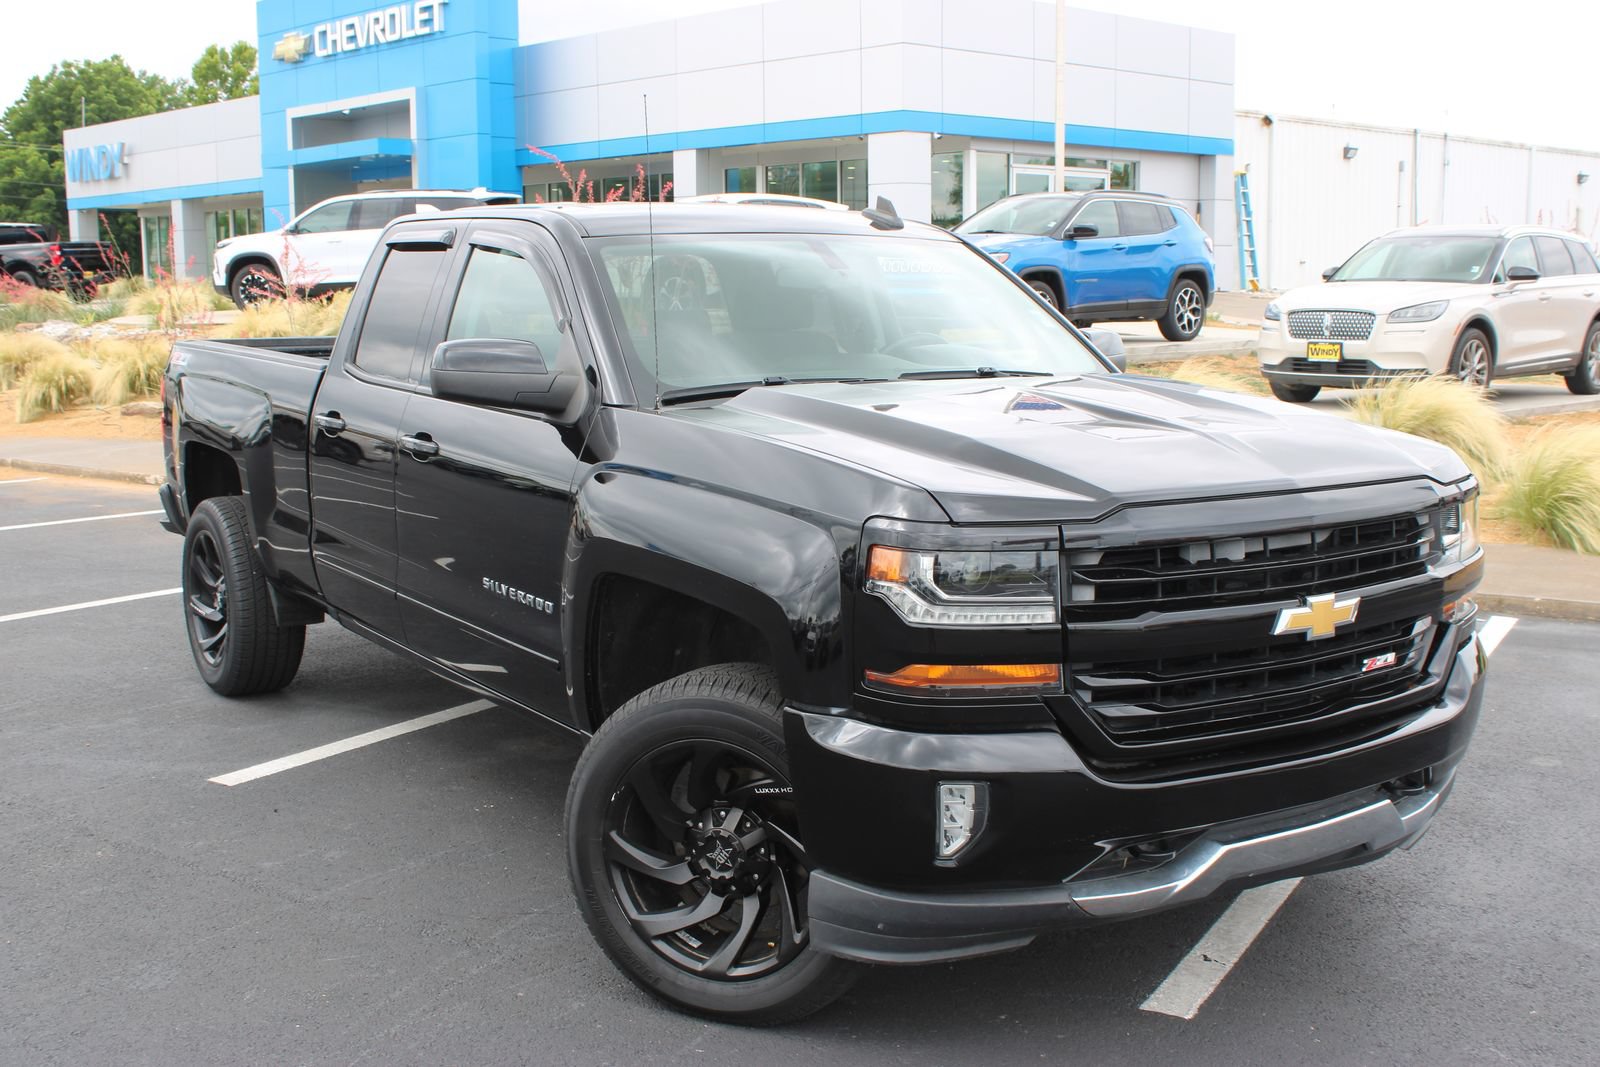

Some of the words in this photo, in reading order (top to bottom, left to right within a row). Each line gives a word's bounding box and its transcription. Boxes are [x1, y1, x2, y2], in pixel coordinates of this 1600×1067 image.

[314, 0, 449, 57] CHEVROLET
[65, 140, 126, 182] WINDY
[1310, 346, 1339, 357] WINDY
[482, 576, 554, 615] SILVERADO
[1361, 652, 1396, 672] Z71
